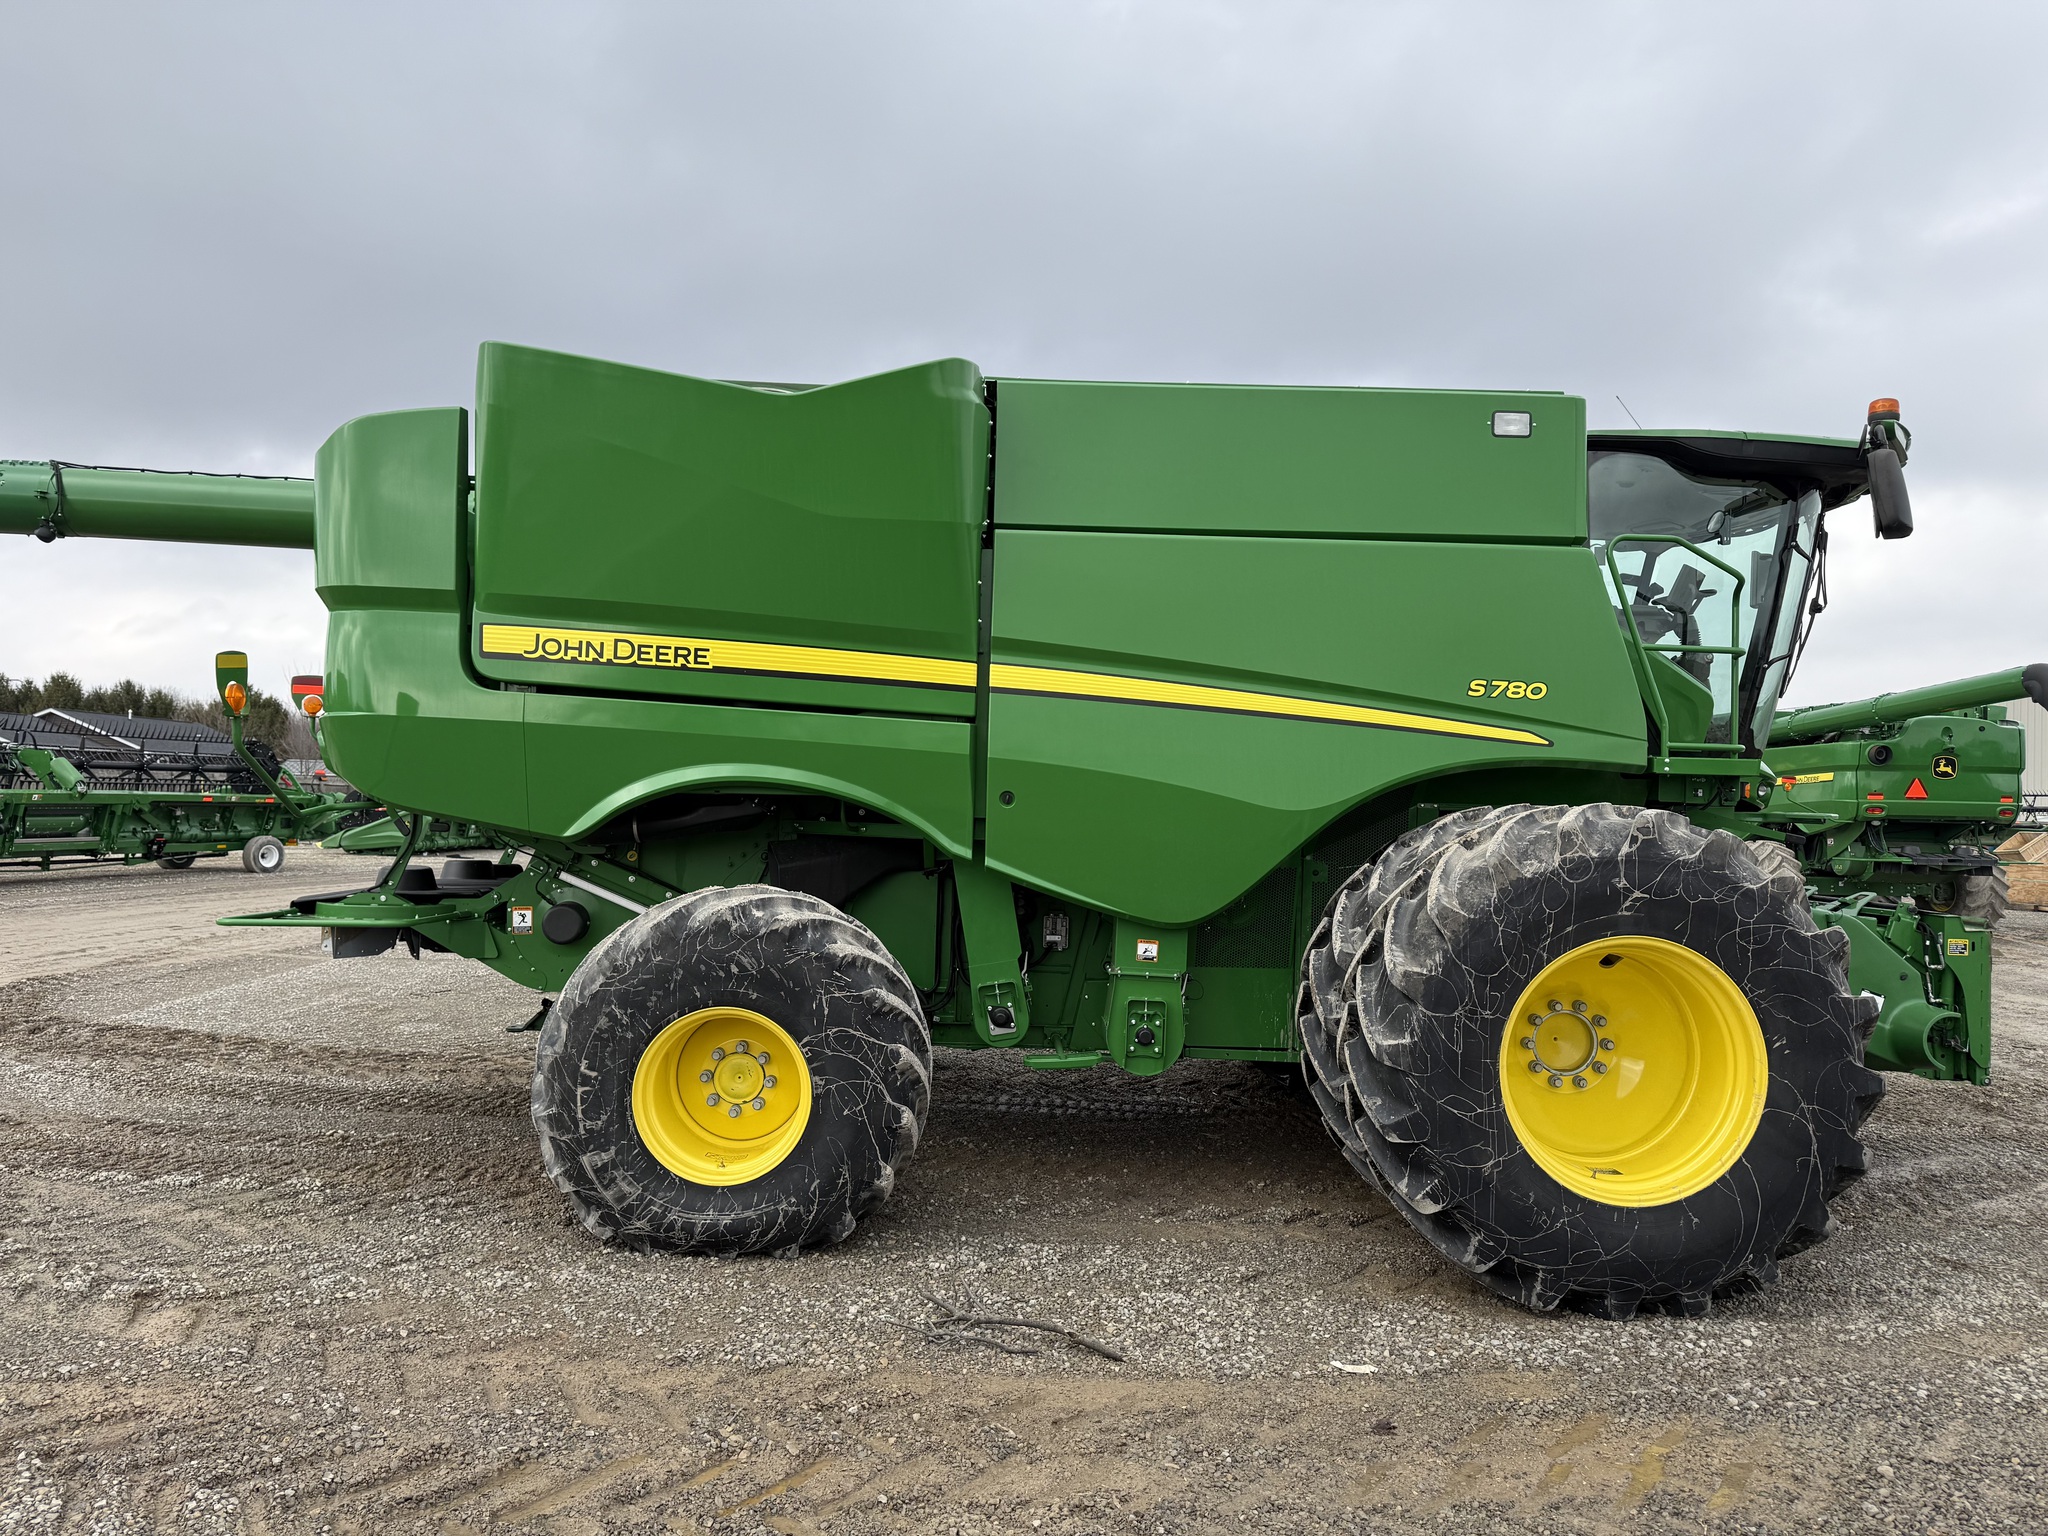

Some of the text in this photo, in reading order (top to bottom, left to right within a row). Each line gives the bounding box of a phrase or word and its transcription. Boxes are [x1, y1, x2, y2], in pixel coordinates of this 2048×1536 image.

[523, 633, 710, 666] JOHN DEERE
[1467, 679, 1548, 700] S780
